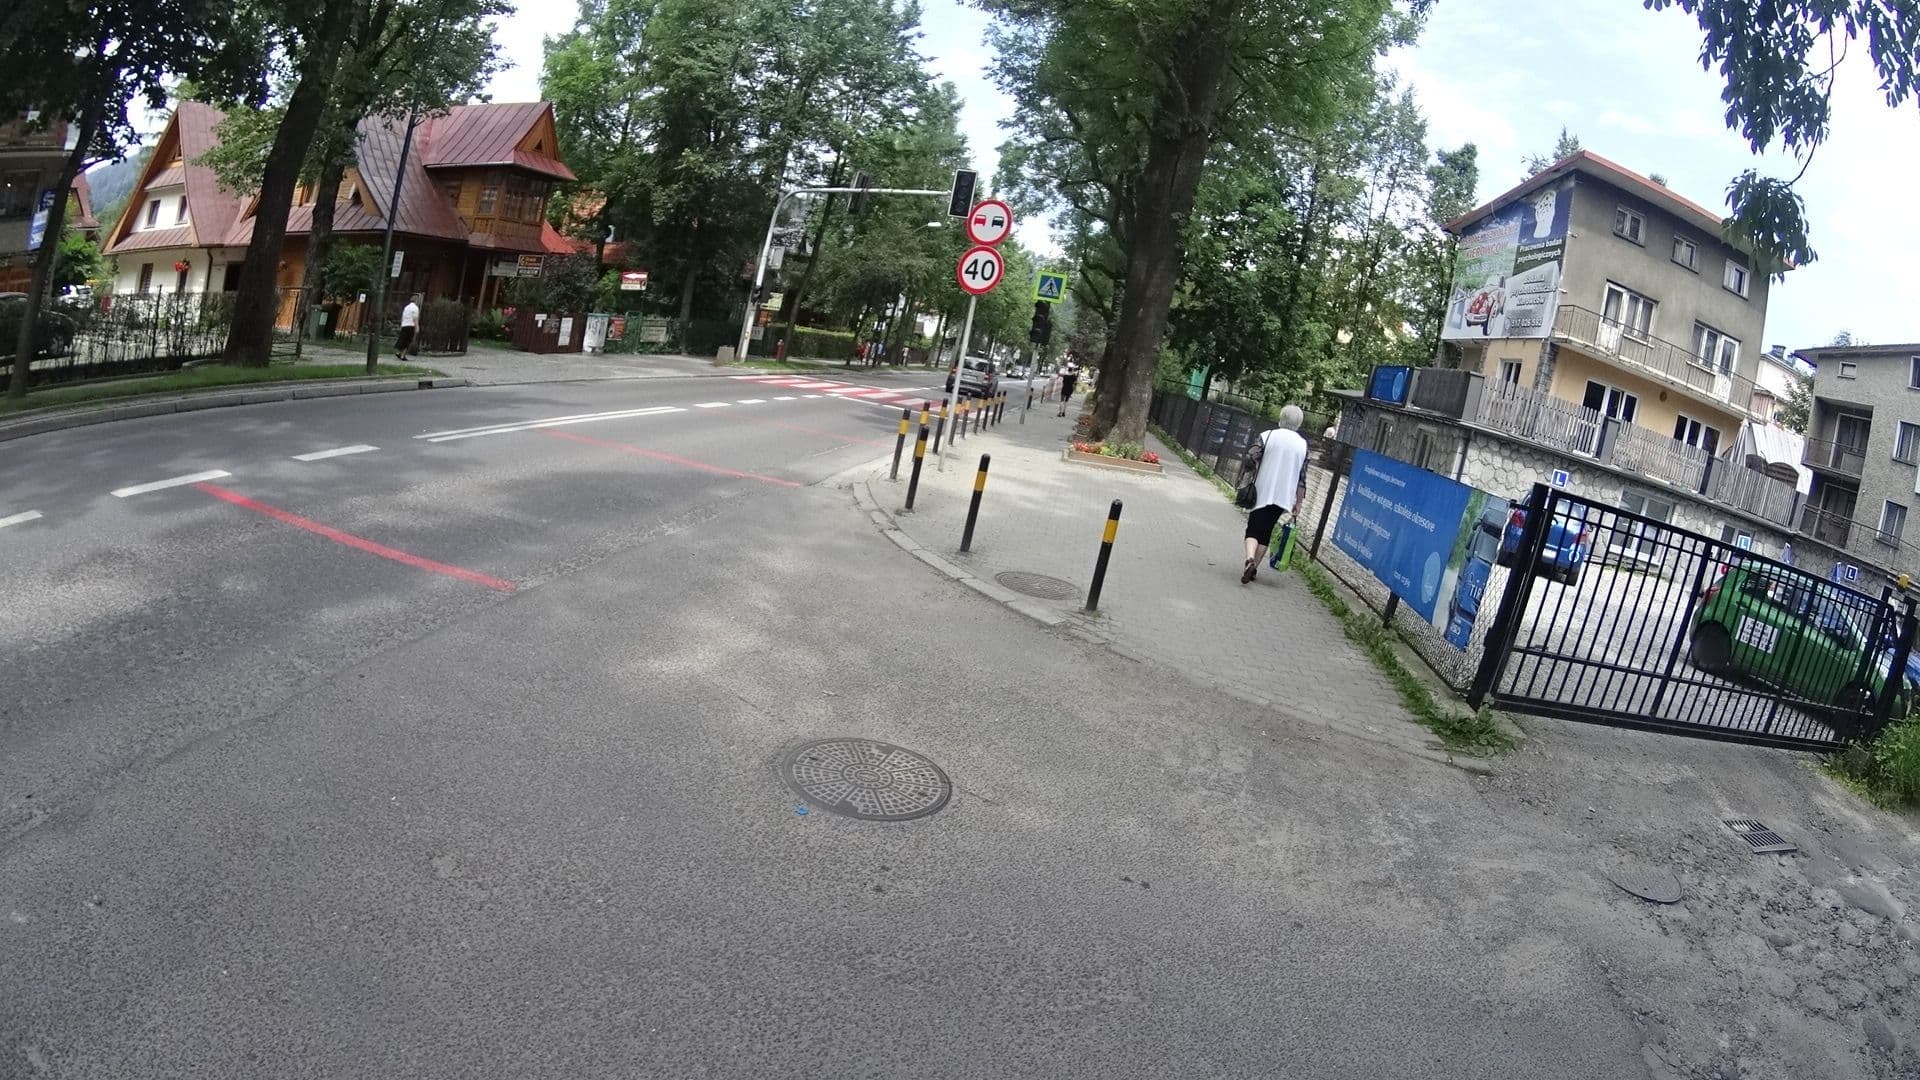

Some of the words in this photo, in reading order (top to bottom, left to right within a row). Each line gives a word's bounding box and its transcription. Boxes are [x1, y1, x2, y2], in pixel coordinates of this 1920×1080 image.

[1519, 242, 1545, 252] Pracownia
[1516, 248, 1562, 264] psychologicznych
[964, 258, 996, 282] 40
[1555, 472, 1563, 486] L
[1848, 568, 1855, 578] L
